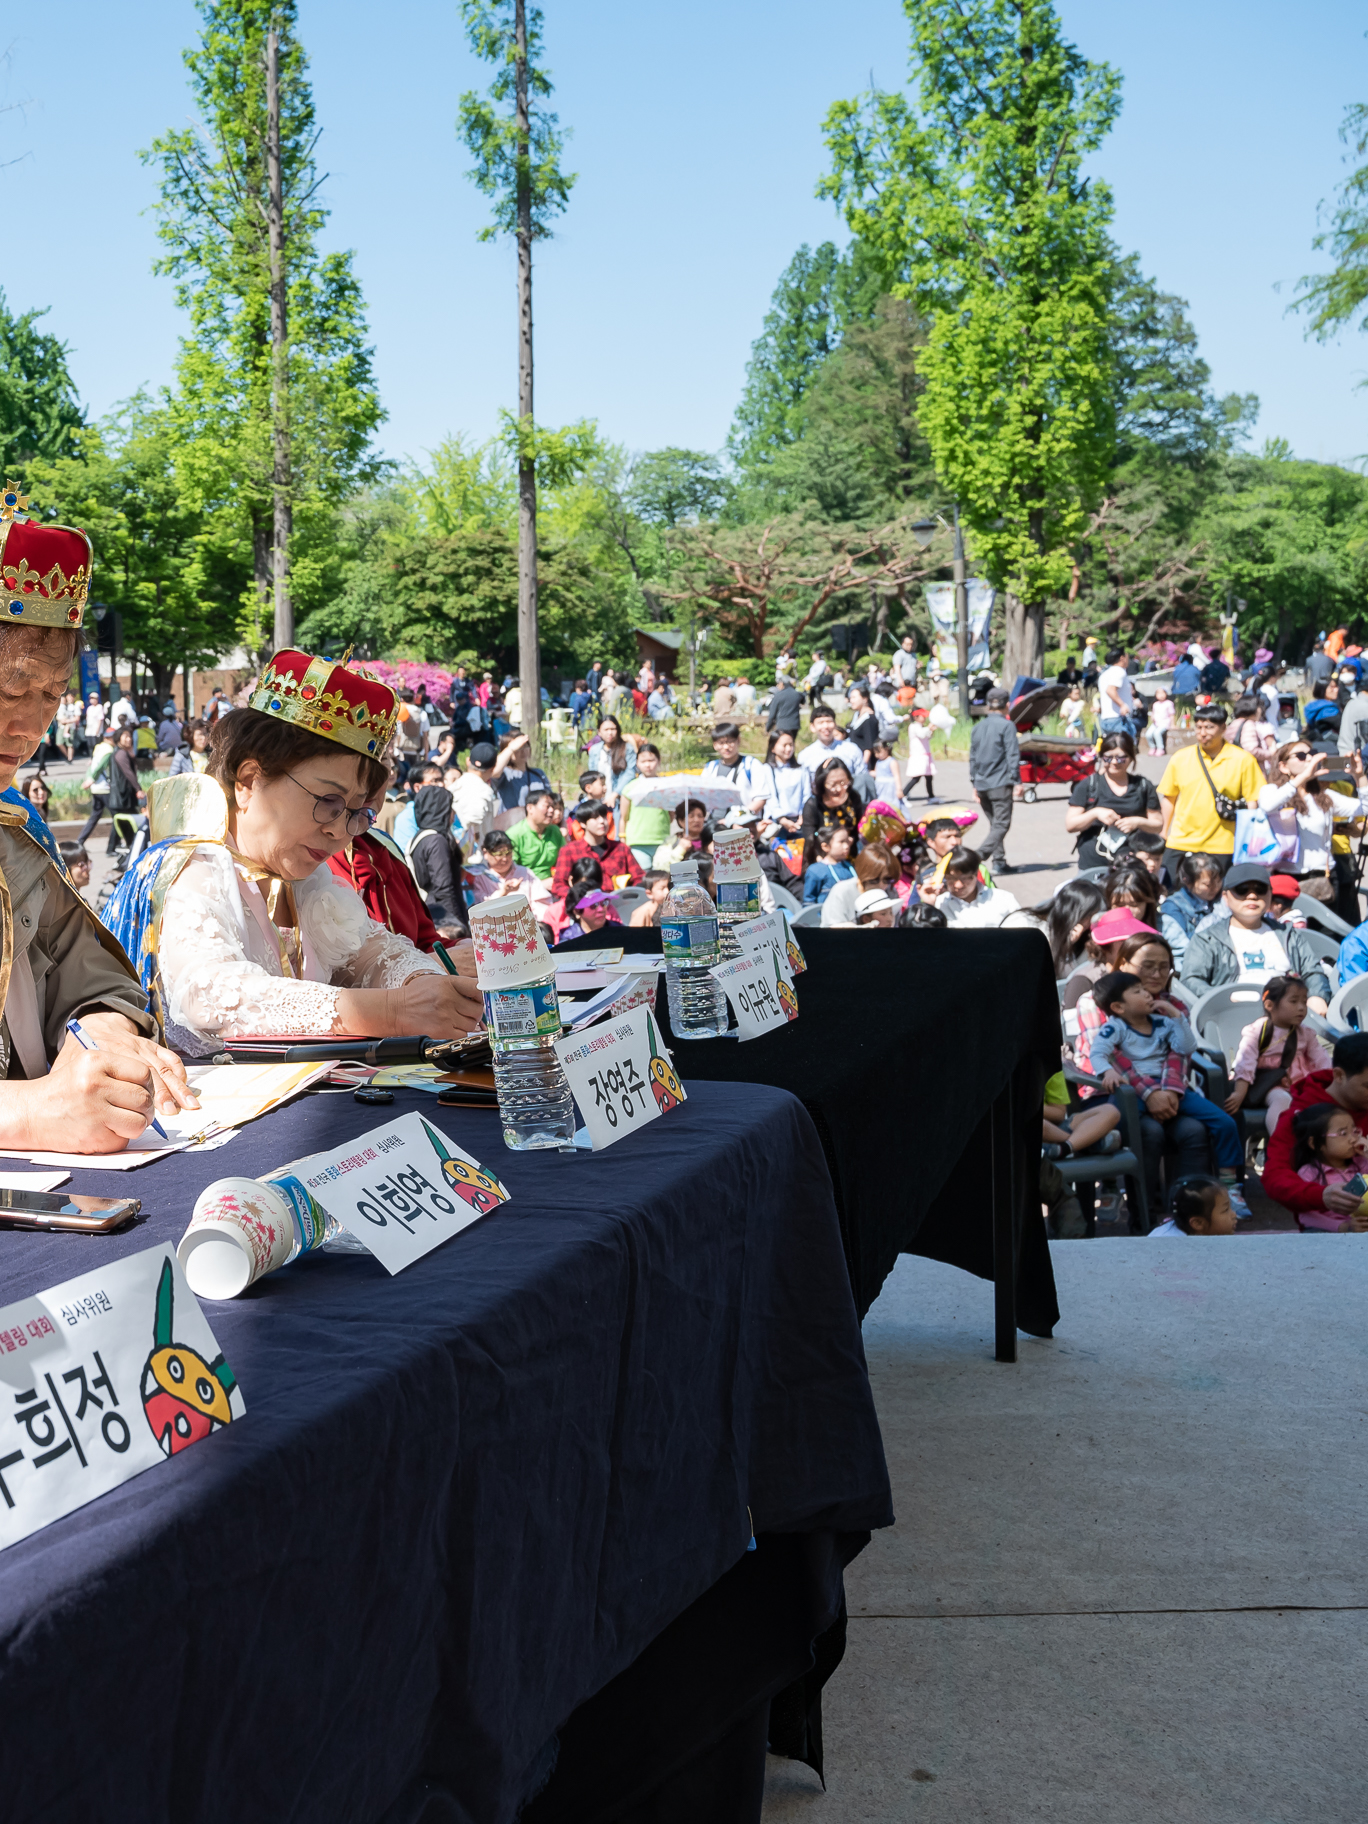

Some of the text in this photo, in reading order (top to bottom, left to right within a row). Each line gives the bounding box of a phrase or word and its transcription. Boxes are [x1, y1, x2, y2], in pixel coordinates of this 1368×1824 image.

[738, 976, 780, 1022] 이규원
[587, 1057, 646, 1128] 장영주
[315, 1172, 332, 1185] 전국
[362, 1147, 380, 1161] 대회
[375, 1134, 406, 1154] 심사위원
[356, 1163, 456, 1235] 이희영
[26, 1315, 56, 1340] 대회
[60, 1290, 114, 1326] 심사위원
